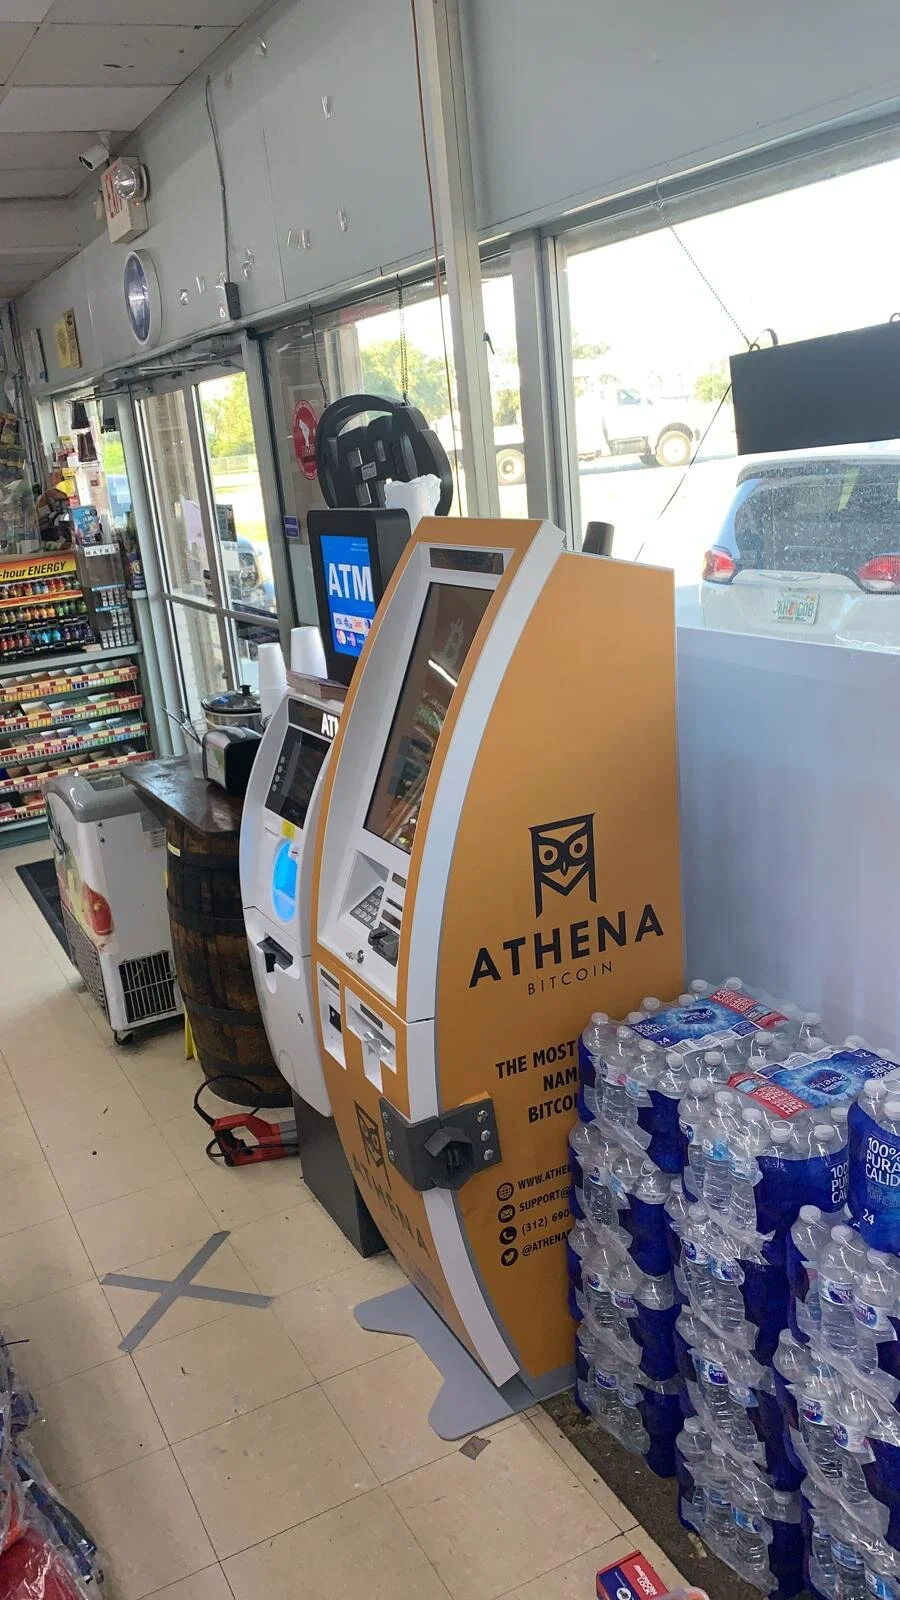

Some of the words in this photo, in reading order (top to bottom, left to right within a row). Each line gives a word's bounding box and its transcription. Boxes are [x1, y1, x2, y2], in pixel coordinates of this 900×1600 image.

[28, 561, 66, 576] ENERGY
[328, 562, 375, 602] ATM
[469, 903, 665, 989] ATHENA
[527, 961, 613, 996] BITCOIN
[495, 1055, 528, 1079] THE
[533, 1040, 576, 1069] MOST
[519, 1185, 570, 1212] SUPPORT@
[522, 1216, 548, 1236] (312)
[551, 1208, 570, 1222] 690
[862, 1208, 875, 1225] 24
[633, 1563, 658, 1596] AMERICAN
